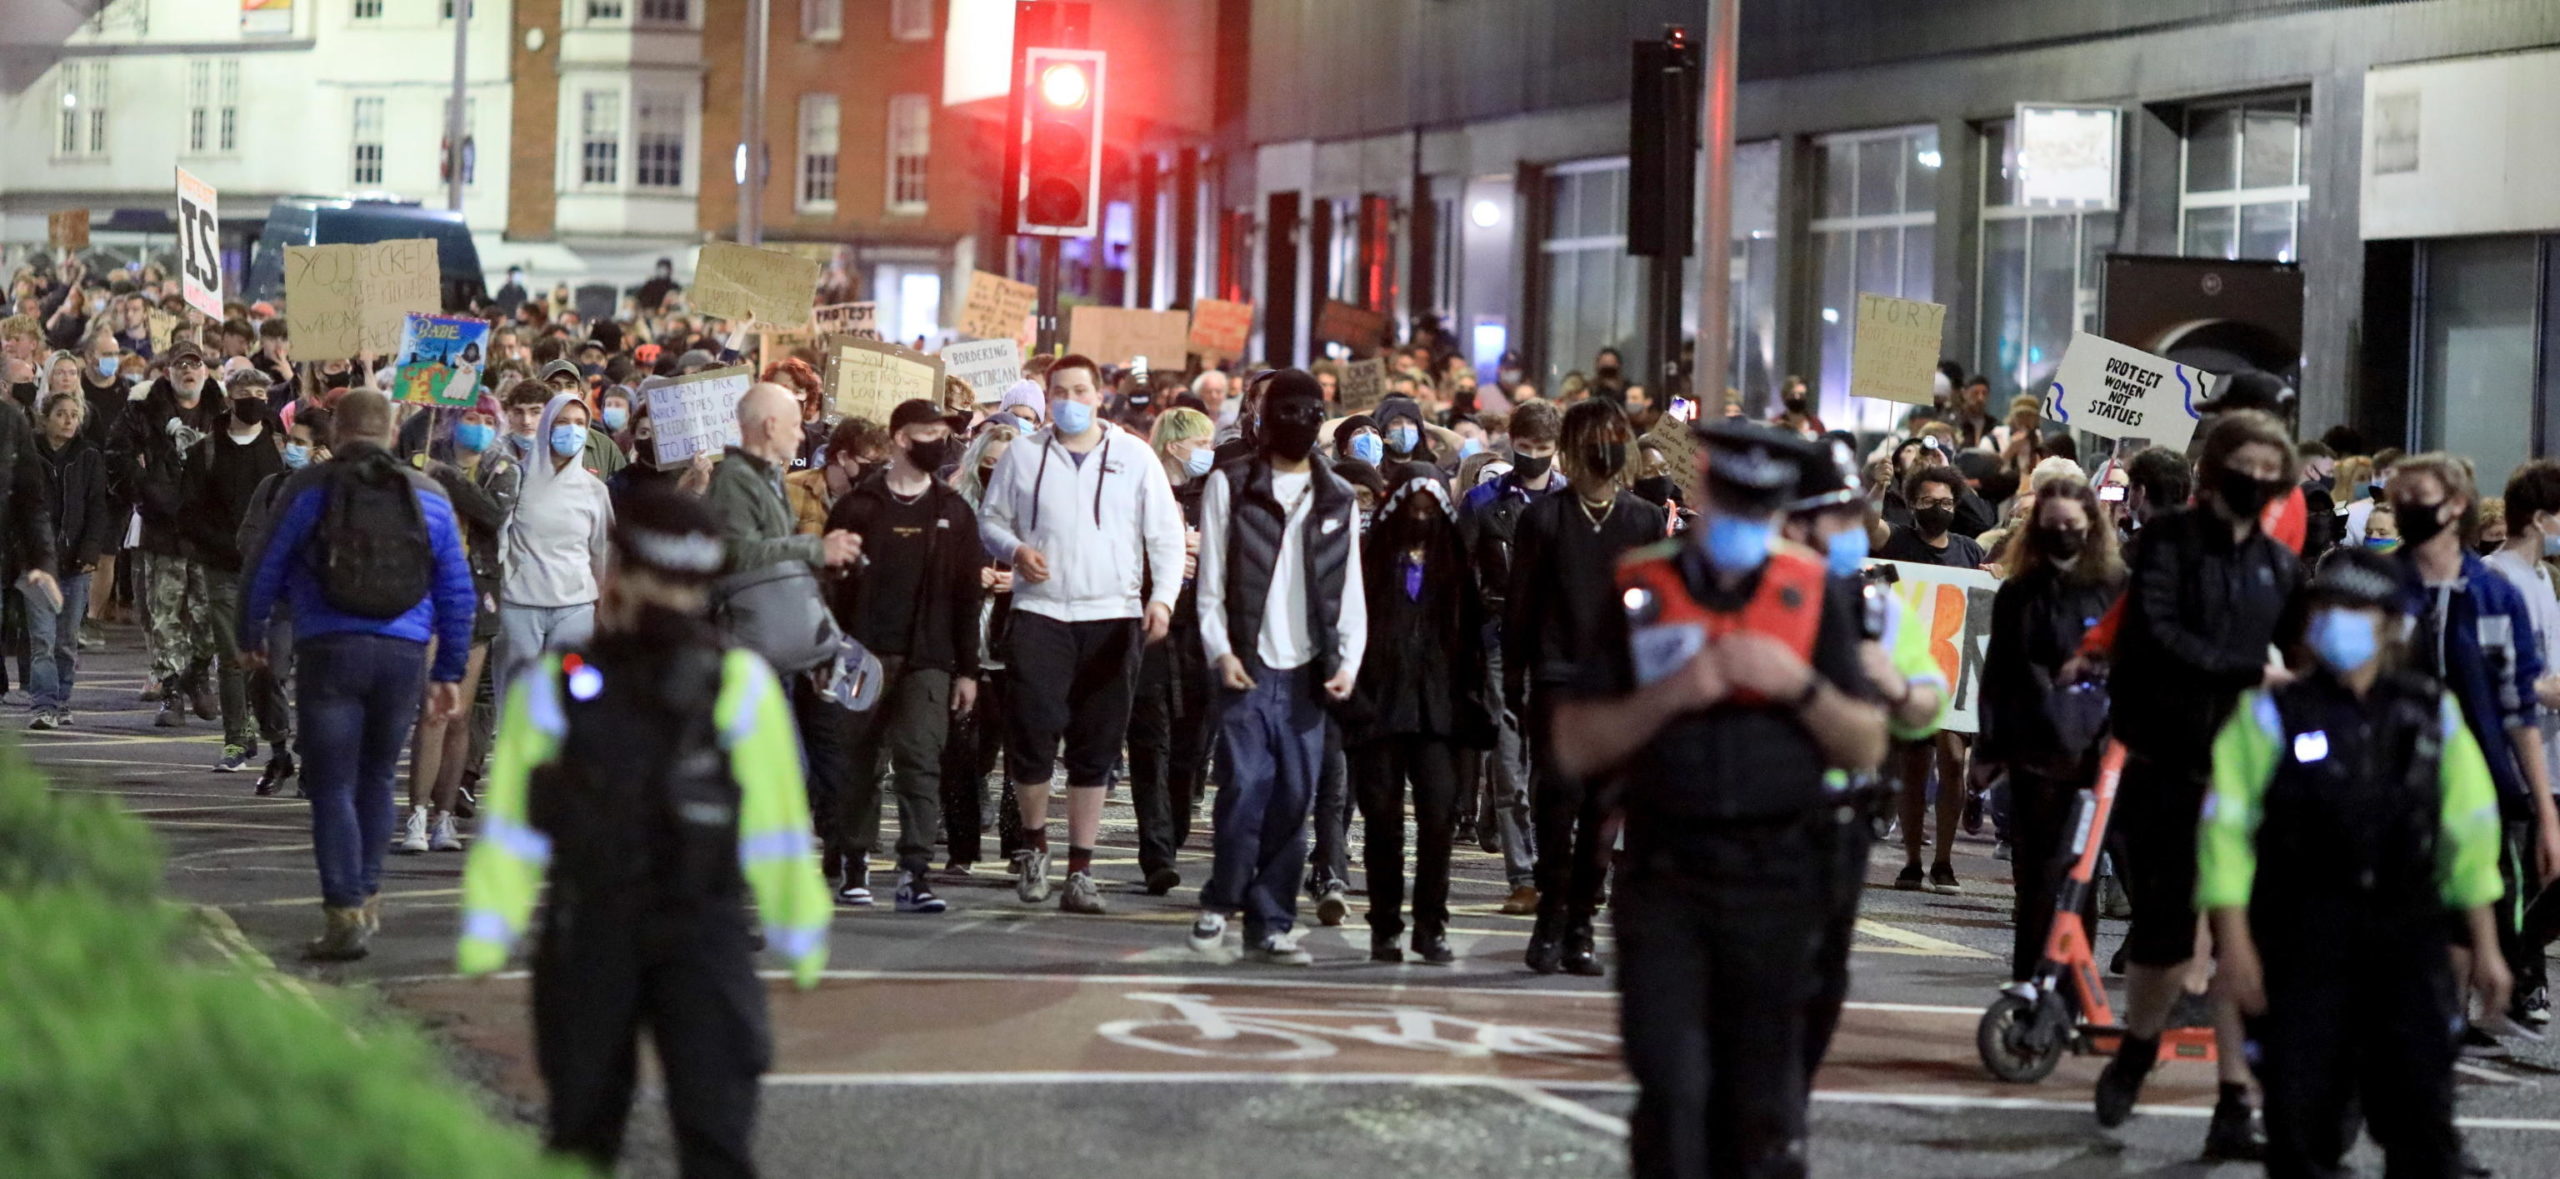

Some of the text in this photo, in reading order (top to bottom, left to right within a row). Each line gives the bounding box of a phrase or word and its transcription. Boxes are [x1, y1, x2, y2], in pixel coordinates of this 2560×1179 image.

[181, 197, 218, 292] IS
[815, 304, 876, 322] PROTEST
[1865, 296, 1942, 329] TORY
[412, 317, 460, 340] BABE
[951, 344, 1008, 367] BORDERING
[2105, 357, 2164, 389] PROTECT
[2104, 375, 2146, 399] WOMEN
[2108, 390, 2132, 407] NOT
[680, 397, 714, 413] TYPES
[722, 392, 736, 408] OF
[2088, 399, 2144, 427] STATUES
[659, 441, 680, 459] TO
